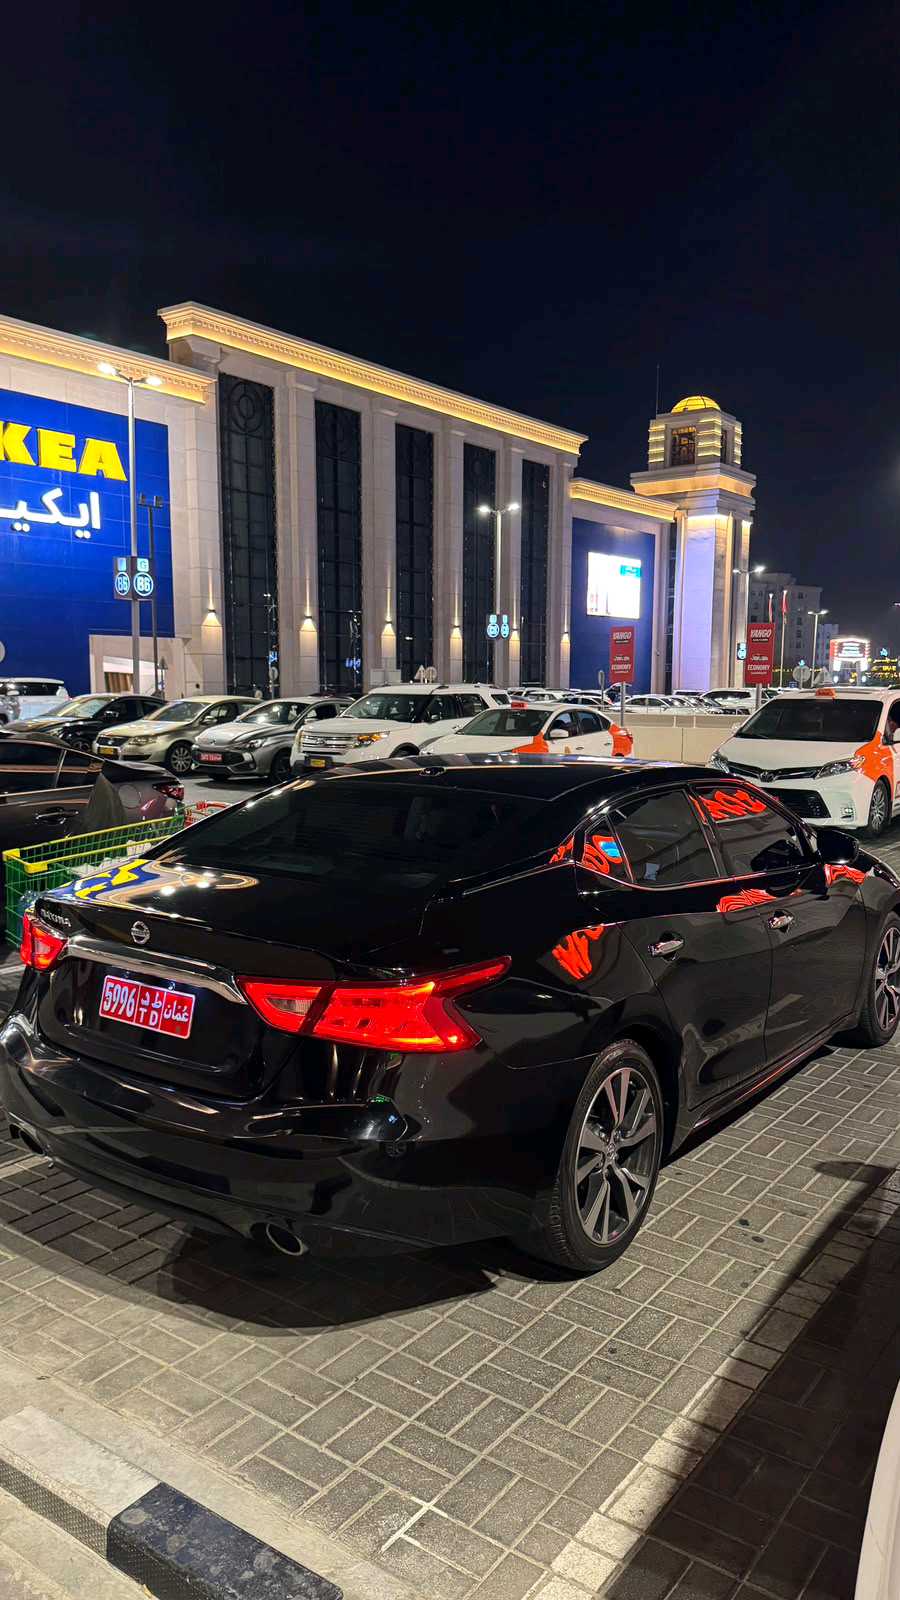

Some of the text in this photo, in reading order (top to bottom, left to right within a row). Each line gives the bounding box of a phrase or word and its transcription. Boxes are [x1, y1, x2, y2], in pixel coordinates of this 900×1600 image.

[0, 421, 128, 481] KEA
[0, 488, 101, 539] ايكي
[750, 629, 772, 638] YANGO
[103, 982, 136, 1017] 5996
